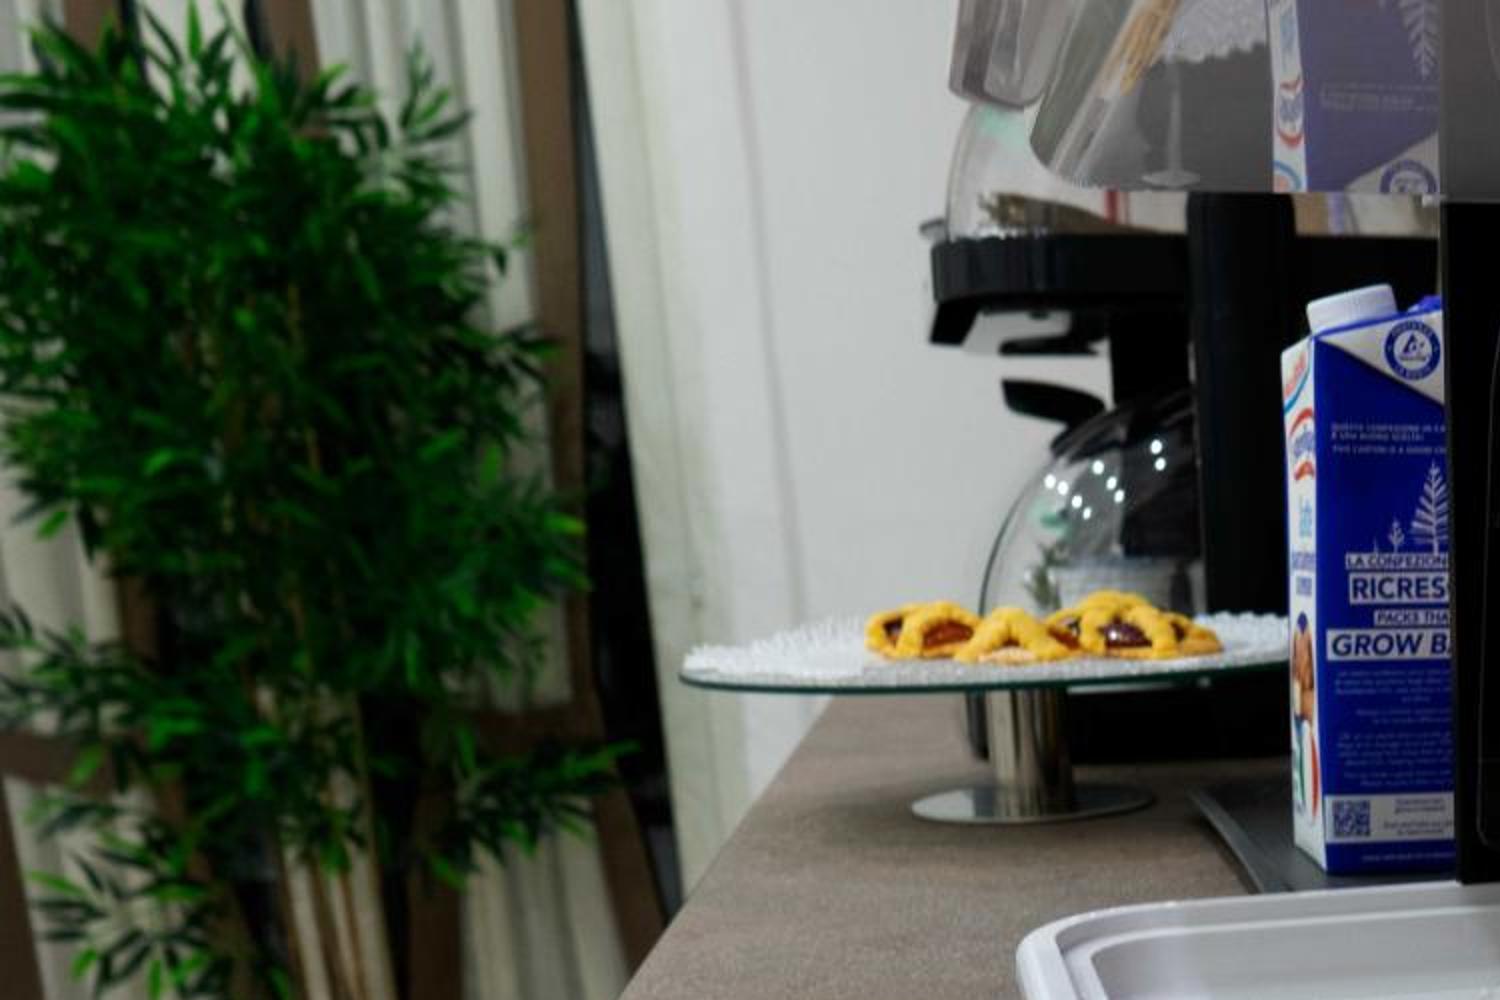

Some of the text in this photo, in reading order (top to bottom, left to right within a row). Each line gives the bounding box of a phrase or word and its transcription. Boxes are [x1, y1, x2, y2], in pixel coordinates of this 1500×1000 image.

[1367, 553, 1448, 567] CONFEZION
[1351, 576, 1449, 600] RICRES
[1425, 610, 1448, 624] THA
[1332, 632, 1450, 657] GROW B
